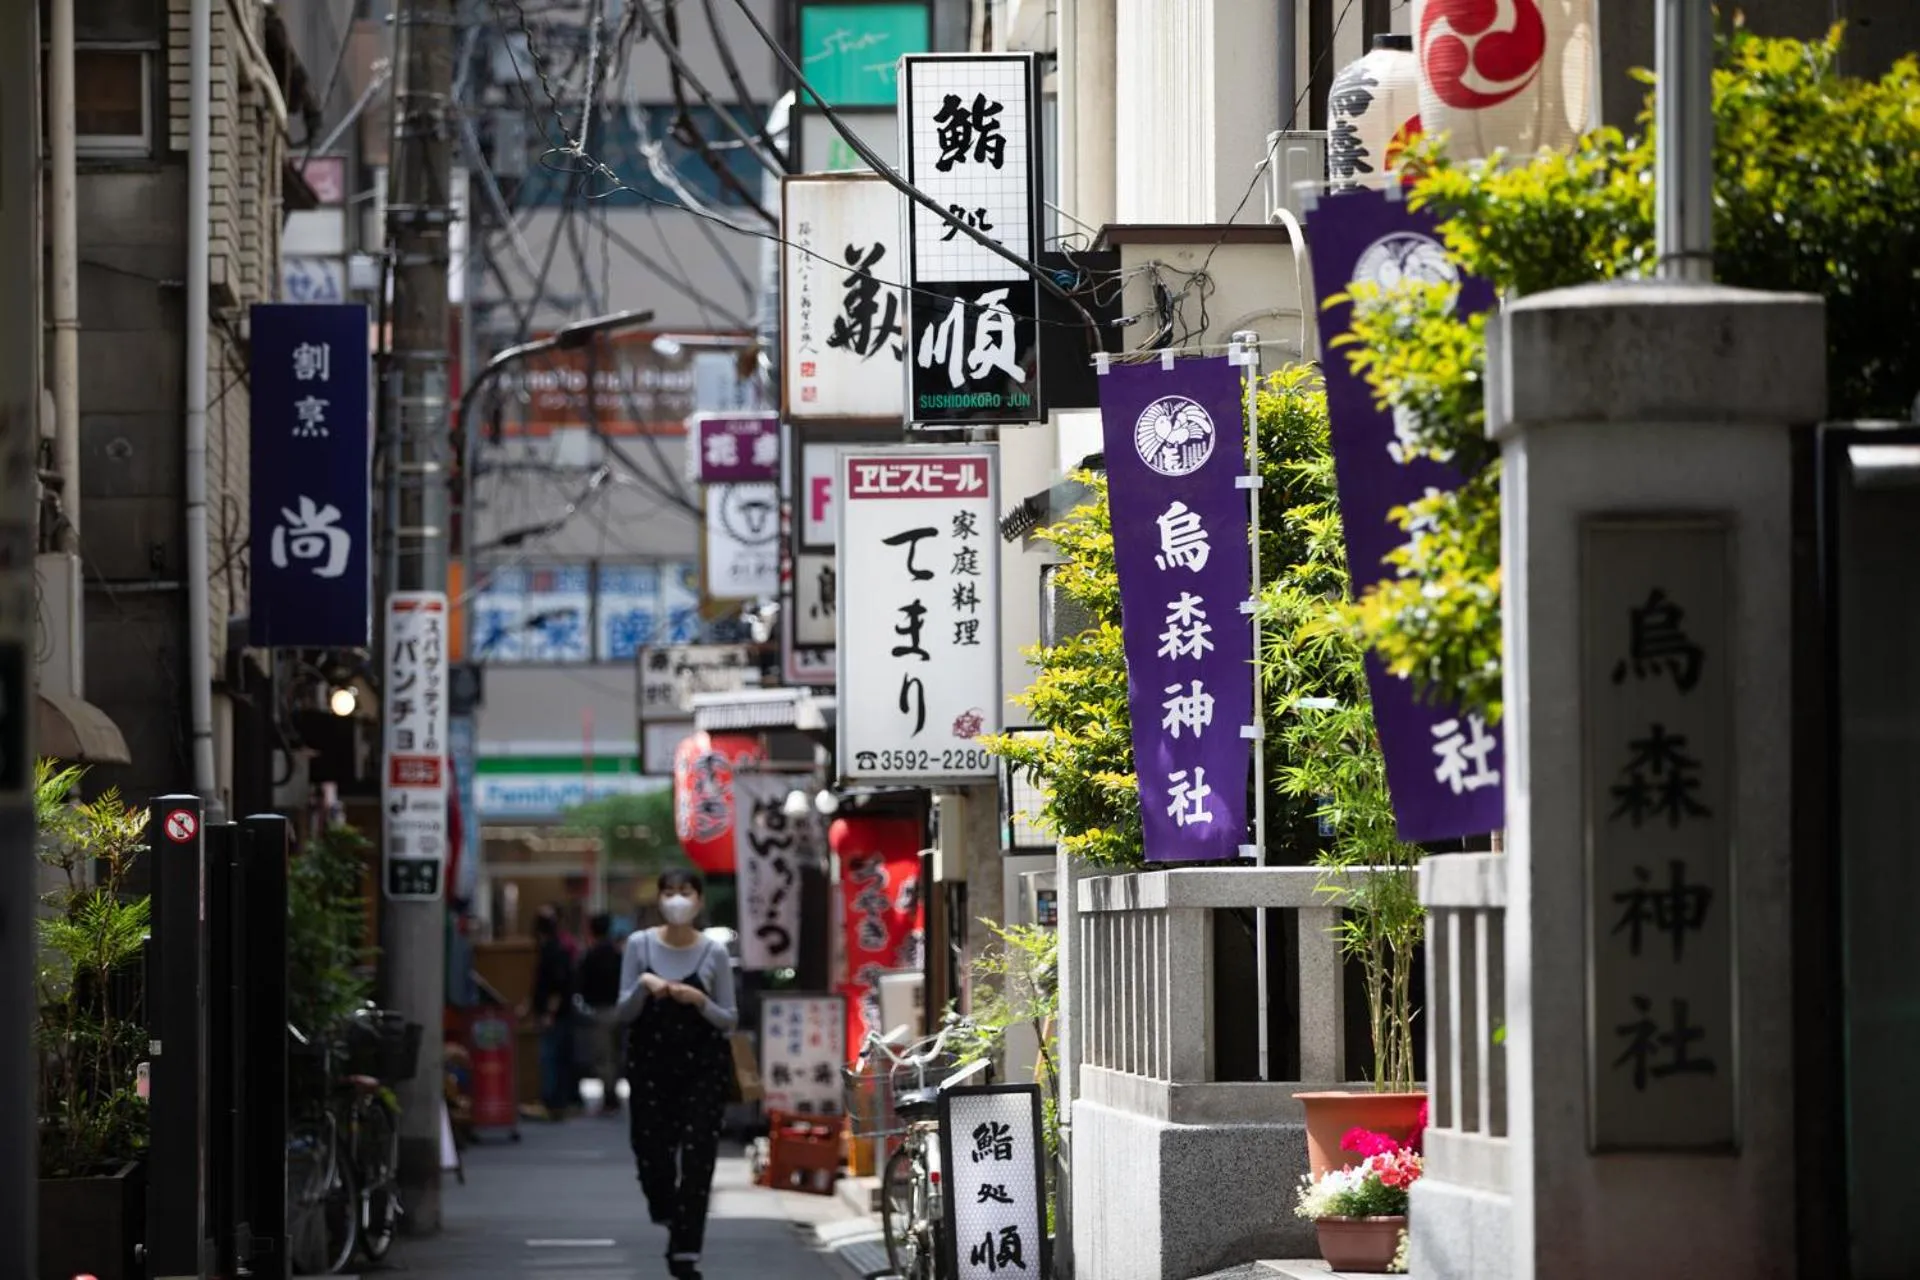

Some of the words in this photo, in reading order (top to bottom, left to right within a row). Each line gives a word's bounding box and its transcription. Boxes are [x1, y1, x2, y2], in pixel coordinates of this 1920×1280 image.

[291, 341, 331, 438] 割烹
[920, 393, 1001, 408] SUSHIDOKORO
[1007, 393, 1031, 408] JUN
[271, 495, 351, 578] 尚
[951, 510, 982, 646] 家庭料理
[881, 526, 939, 737] てまり
[1154, 501, 1215, 826] 烏森神社
[881, 749, 991, 771] 3592-2280
[1610, 588, 1717, 1091] 烏森神社
[970, 1121, 1026, 1272] 鮨処順
